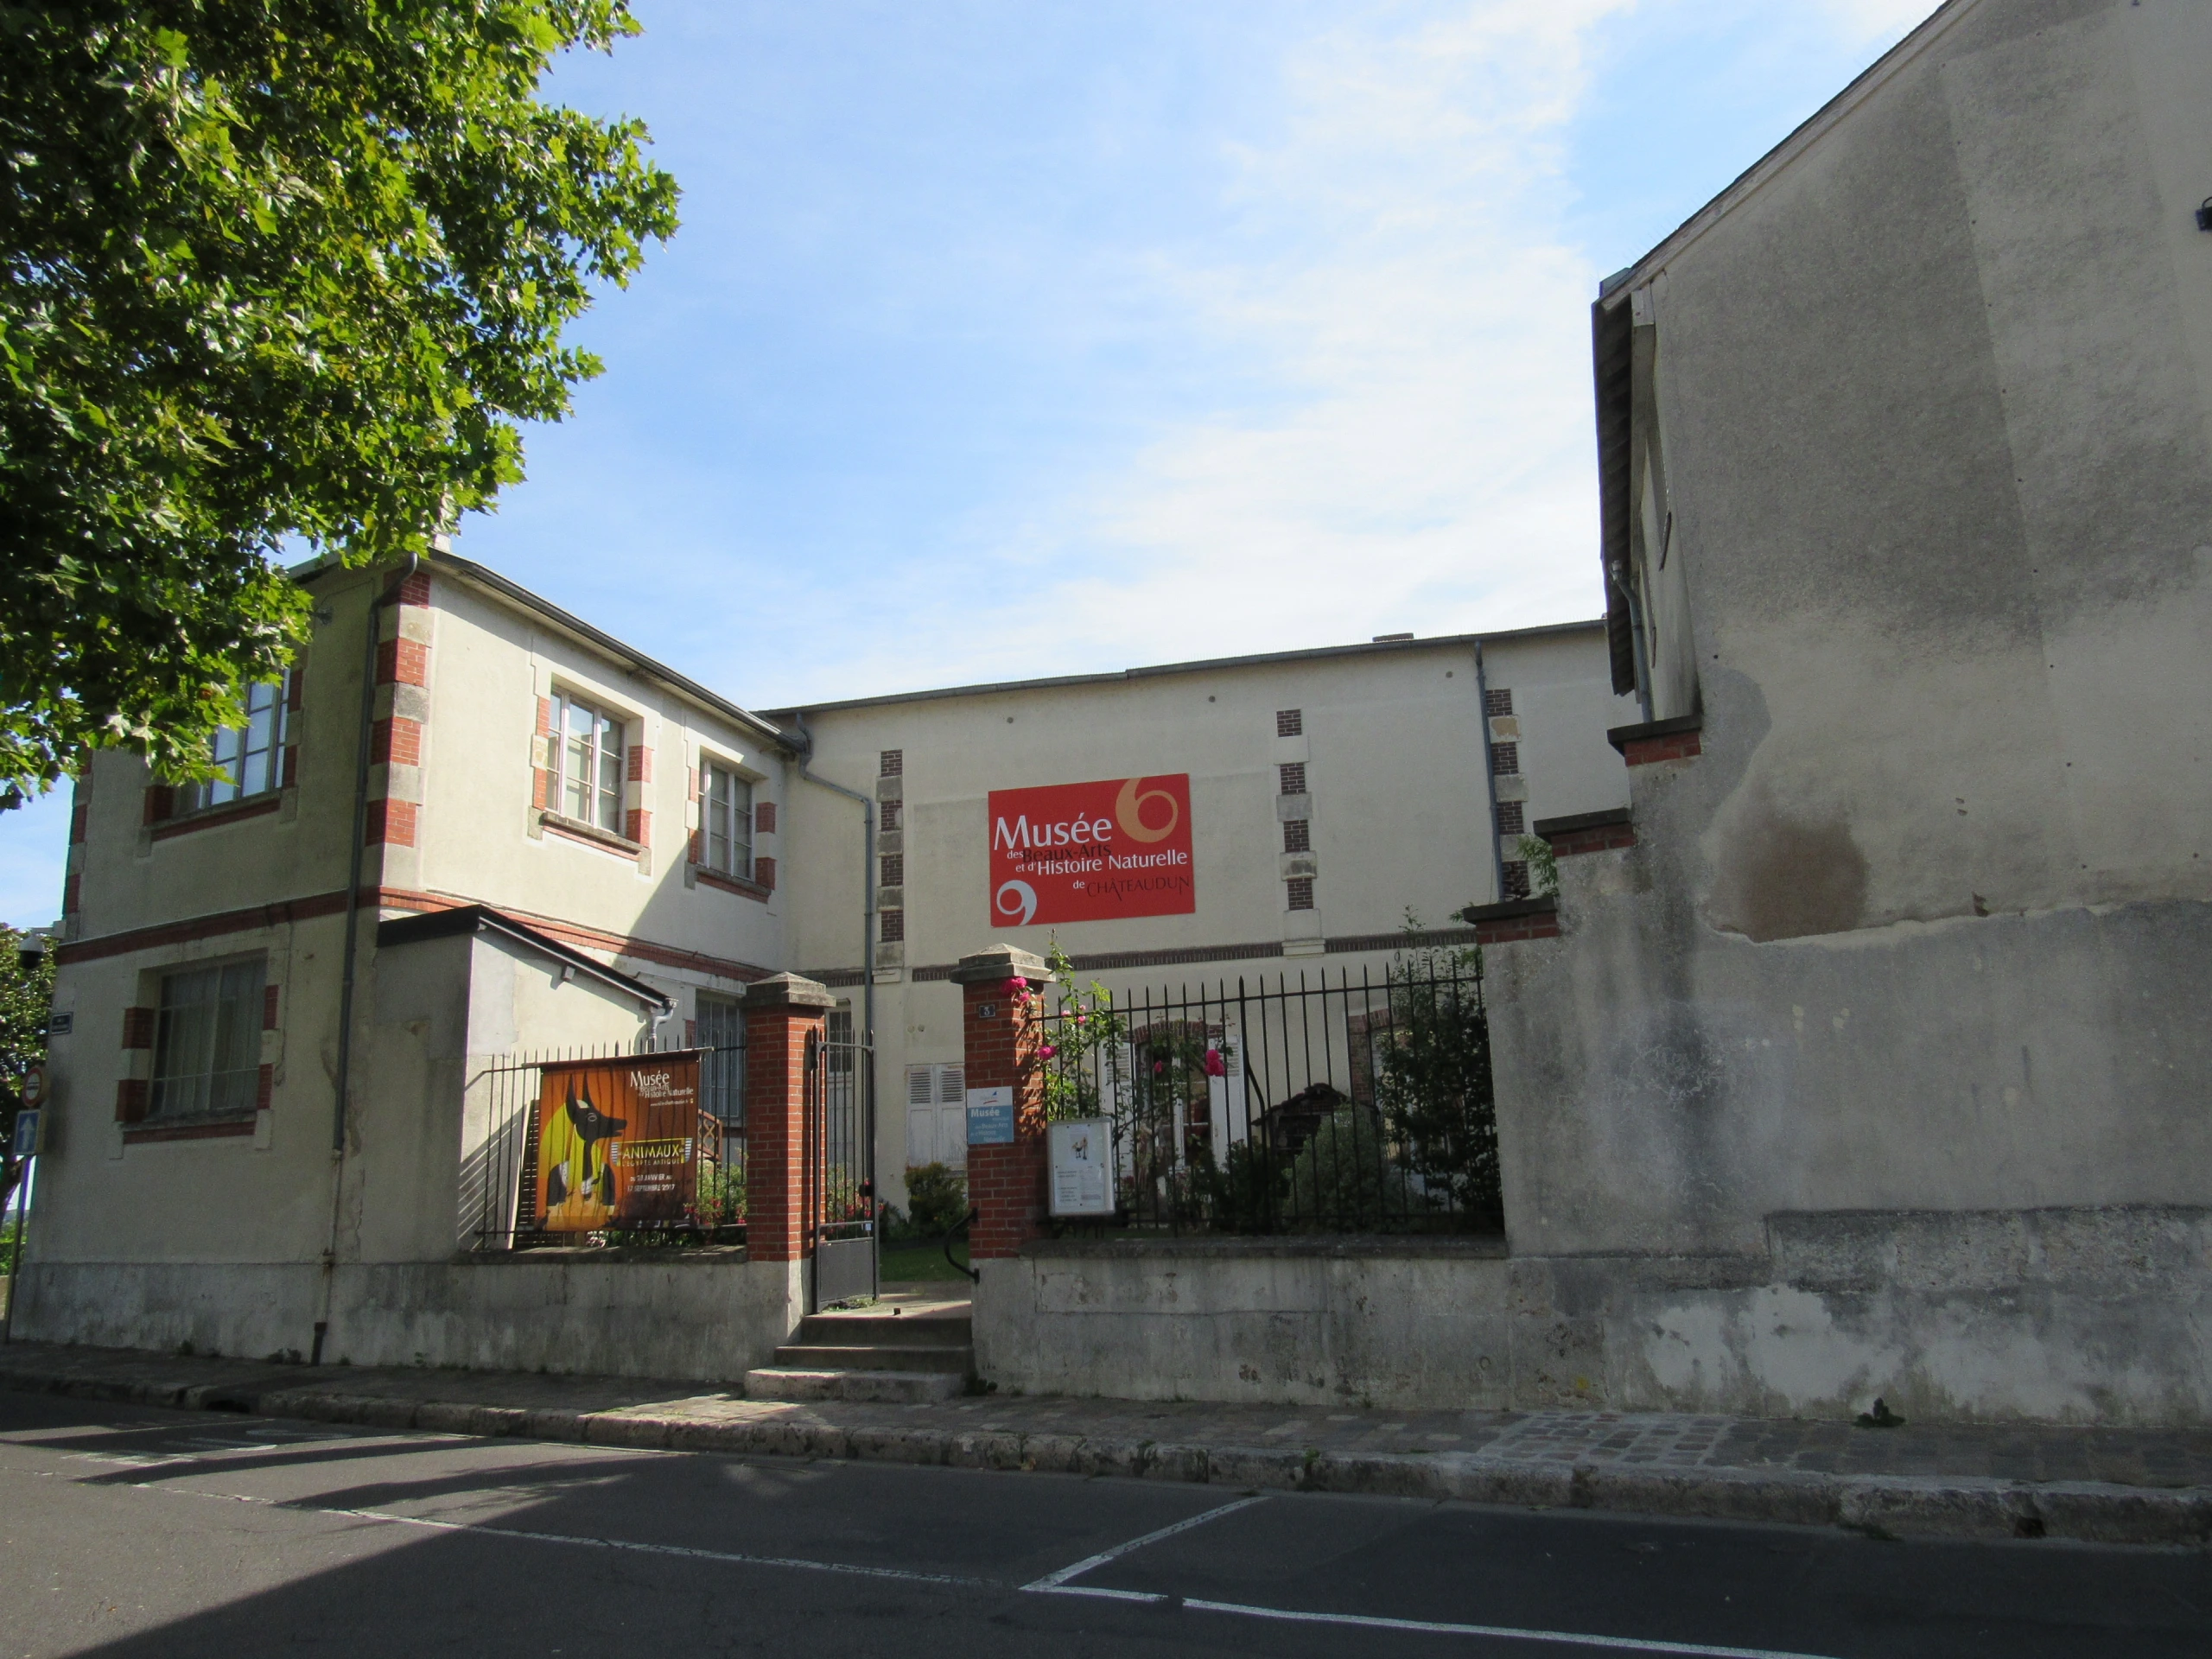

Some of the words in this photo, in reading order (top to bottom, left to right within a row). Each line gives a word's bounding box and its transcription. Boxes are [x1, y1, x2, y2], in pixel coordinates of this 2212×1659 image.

[994, 812, 1112, 850] Musée
[1007, 850, 1024, 859] des
[1022, 843, 1112, 863] Beaux-Arts
[1109, 849, 1188, 870] Naturelle
[1072, 880, 1085, 889] de
[1087, 875, 1190, 901] CHÂTEAUDUN
[983, 1007, 990, 1016] 3
[630, 1070, 670, 1087] Musée
[970, 1107, 1000, 1118] Musée
[622, 1144, 679, 1160] ANIMAUX
